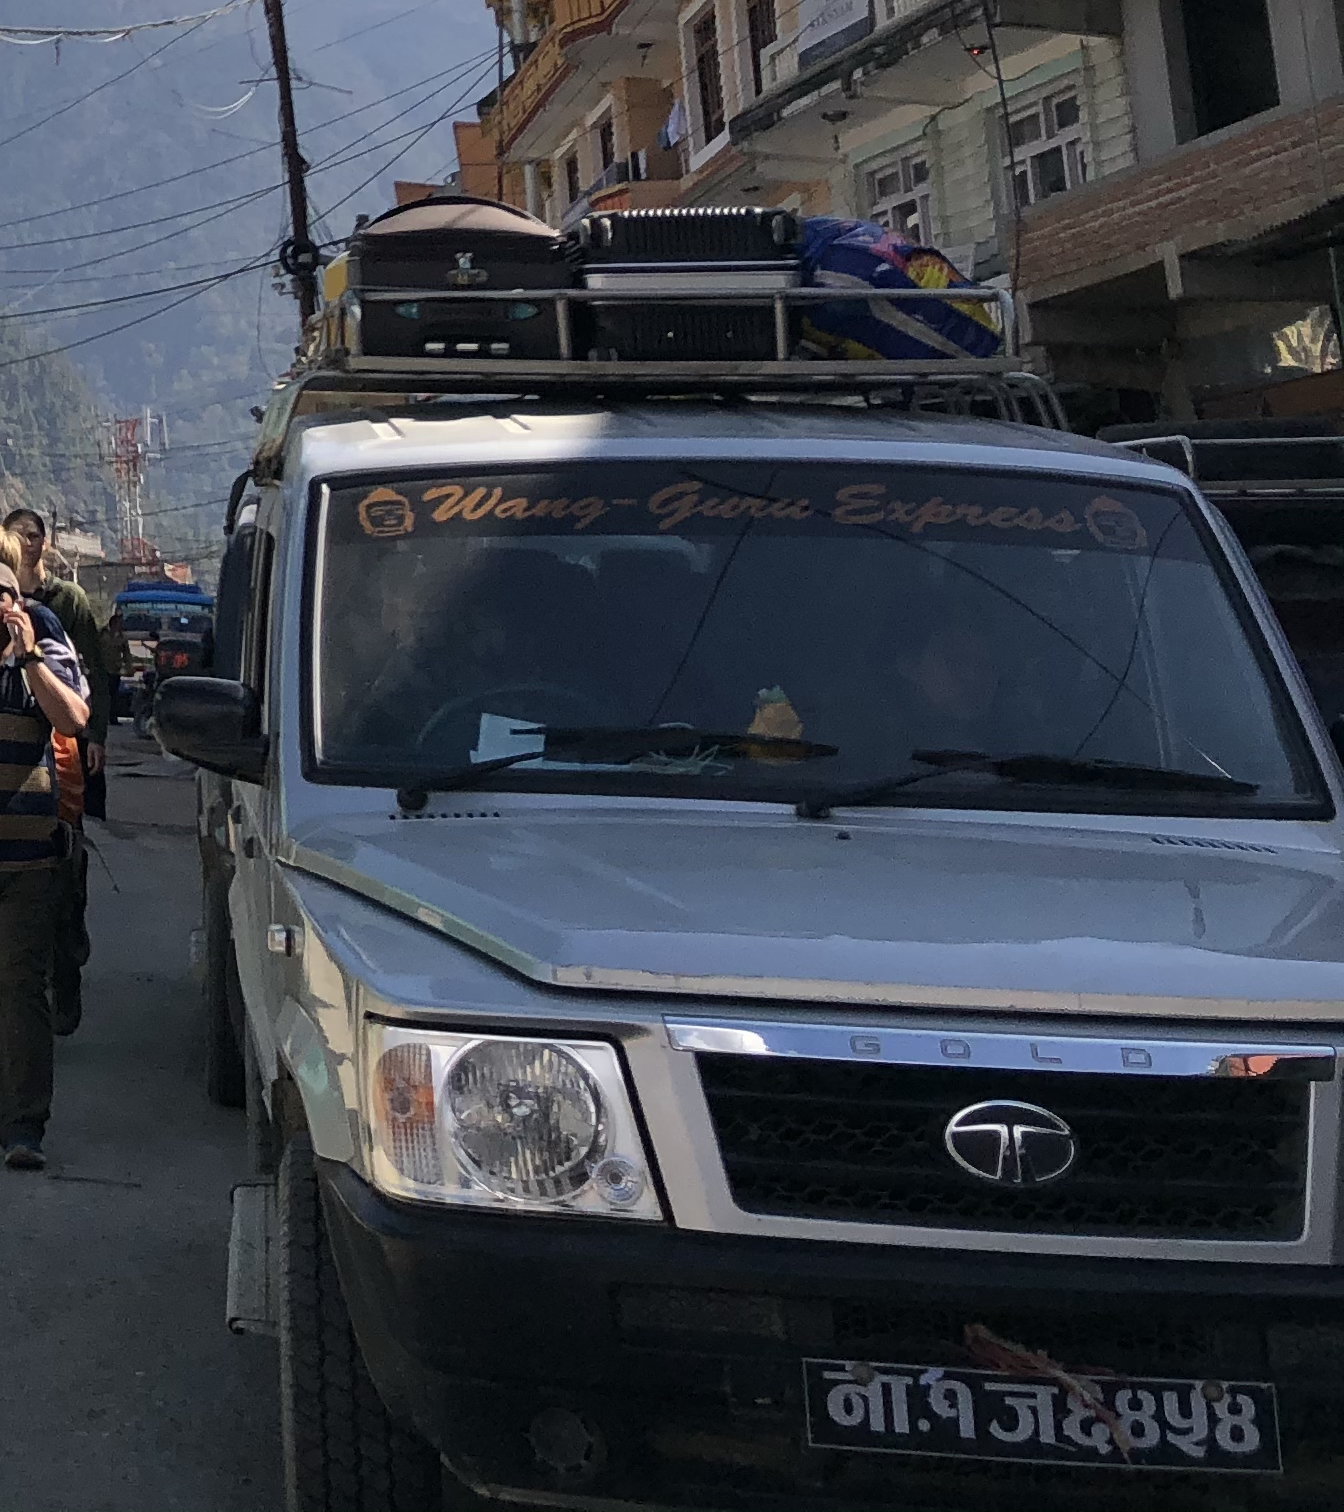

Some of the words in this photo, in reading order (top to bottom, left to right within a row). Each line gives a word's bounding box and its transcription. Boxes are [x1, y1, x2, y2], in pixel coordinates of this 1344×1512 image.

[422, 479, 816, 532] Wang-Guru
[834, 483, 1086, 535] Express
[849, 1034, 1153, 1070] GOLD
